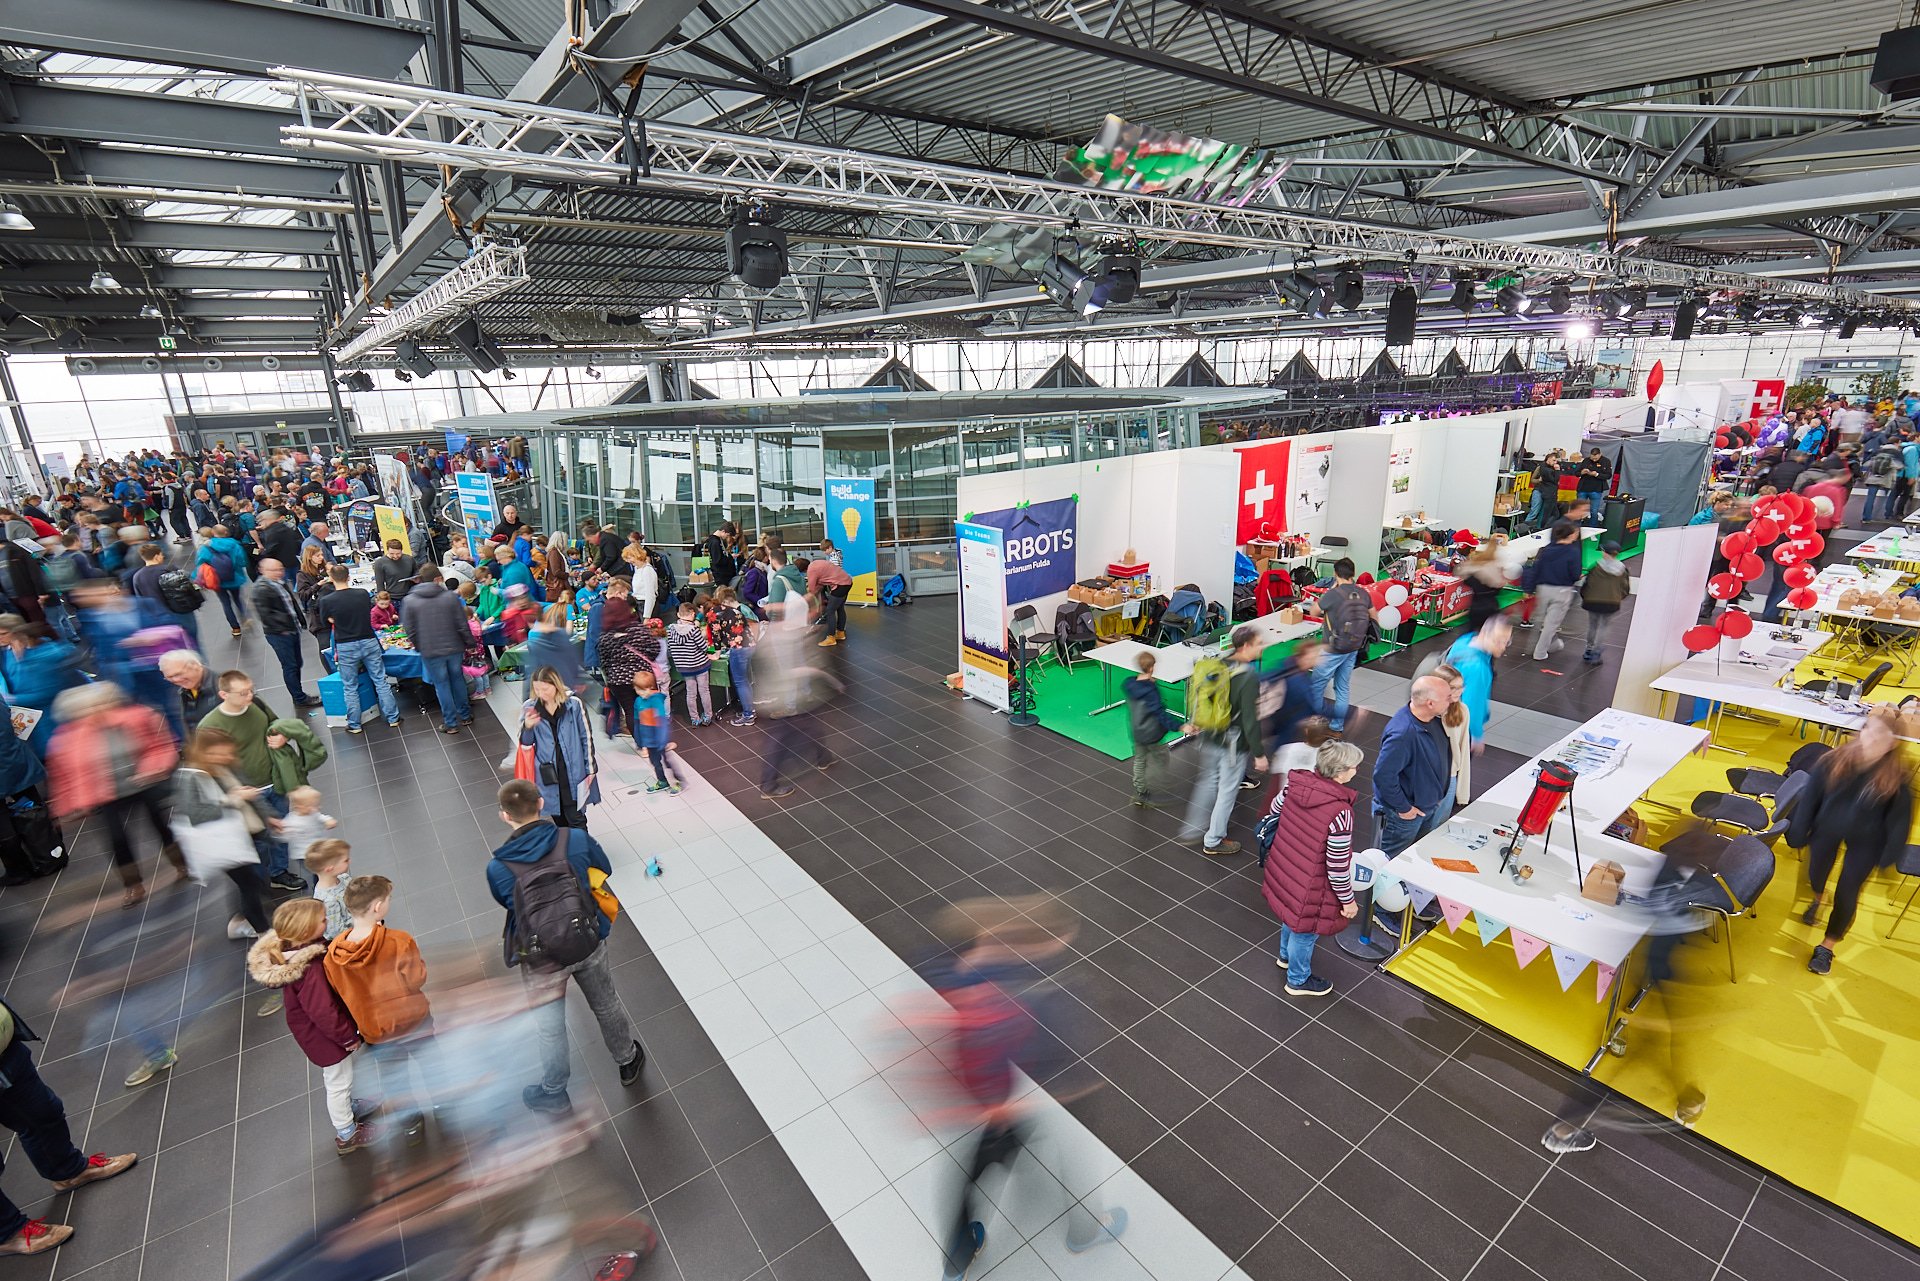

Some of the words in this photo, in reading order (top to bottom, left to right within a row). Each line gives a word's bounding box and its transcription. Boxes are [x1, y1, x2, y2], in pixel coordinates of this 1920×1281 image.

[831, 484, 852, 493] Build
[838, 493, 870, 502] Change
[974, 531, 991, 540] Teams
[1004, 528, 1074, 563] RBOTS
[1033, 558, 1051, 569] Fulda
